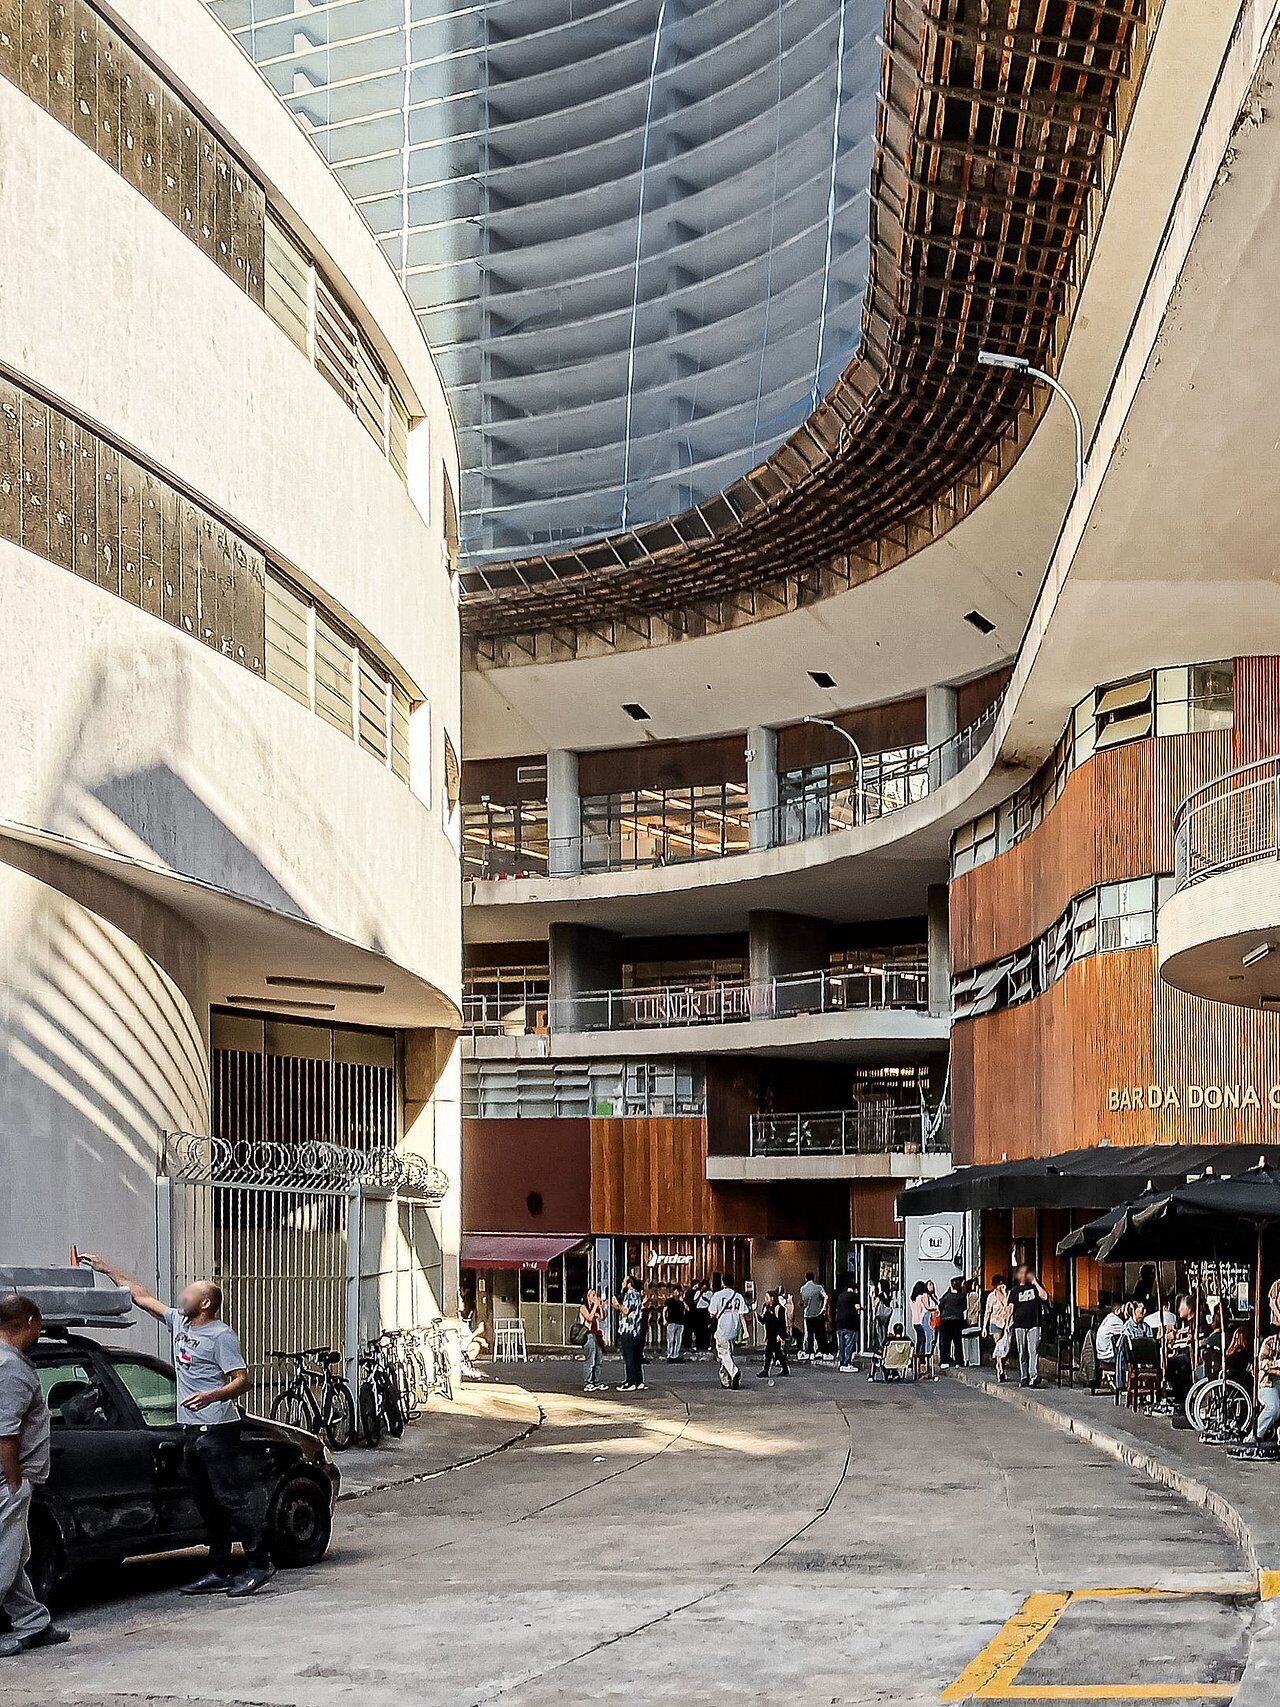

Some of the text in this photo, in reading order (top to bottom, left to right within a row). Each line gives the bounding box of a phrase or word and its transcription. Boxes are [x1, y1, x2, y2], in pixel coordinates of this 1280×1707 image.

[1108, 1087, 1144, 1111] BAR
[1148, 1084, 1180, 1109] DA
[1187, 1084, 1261, 1109] DONA
[929, 1237, 943, 1248] tu!
